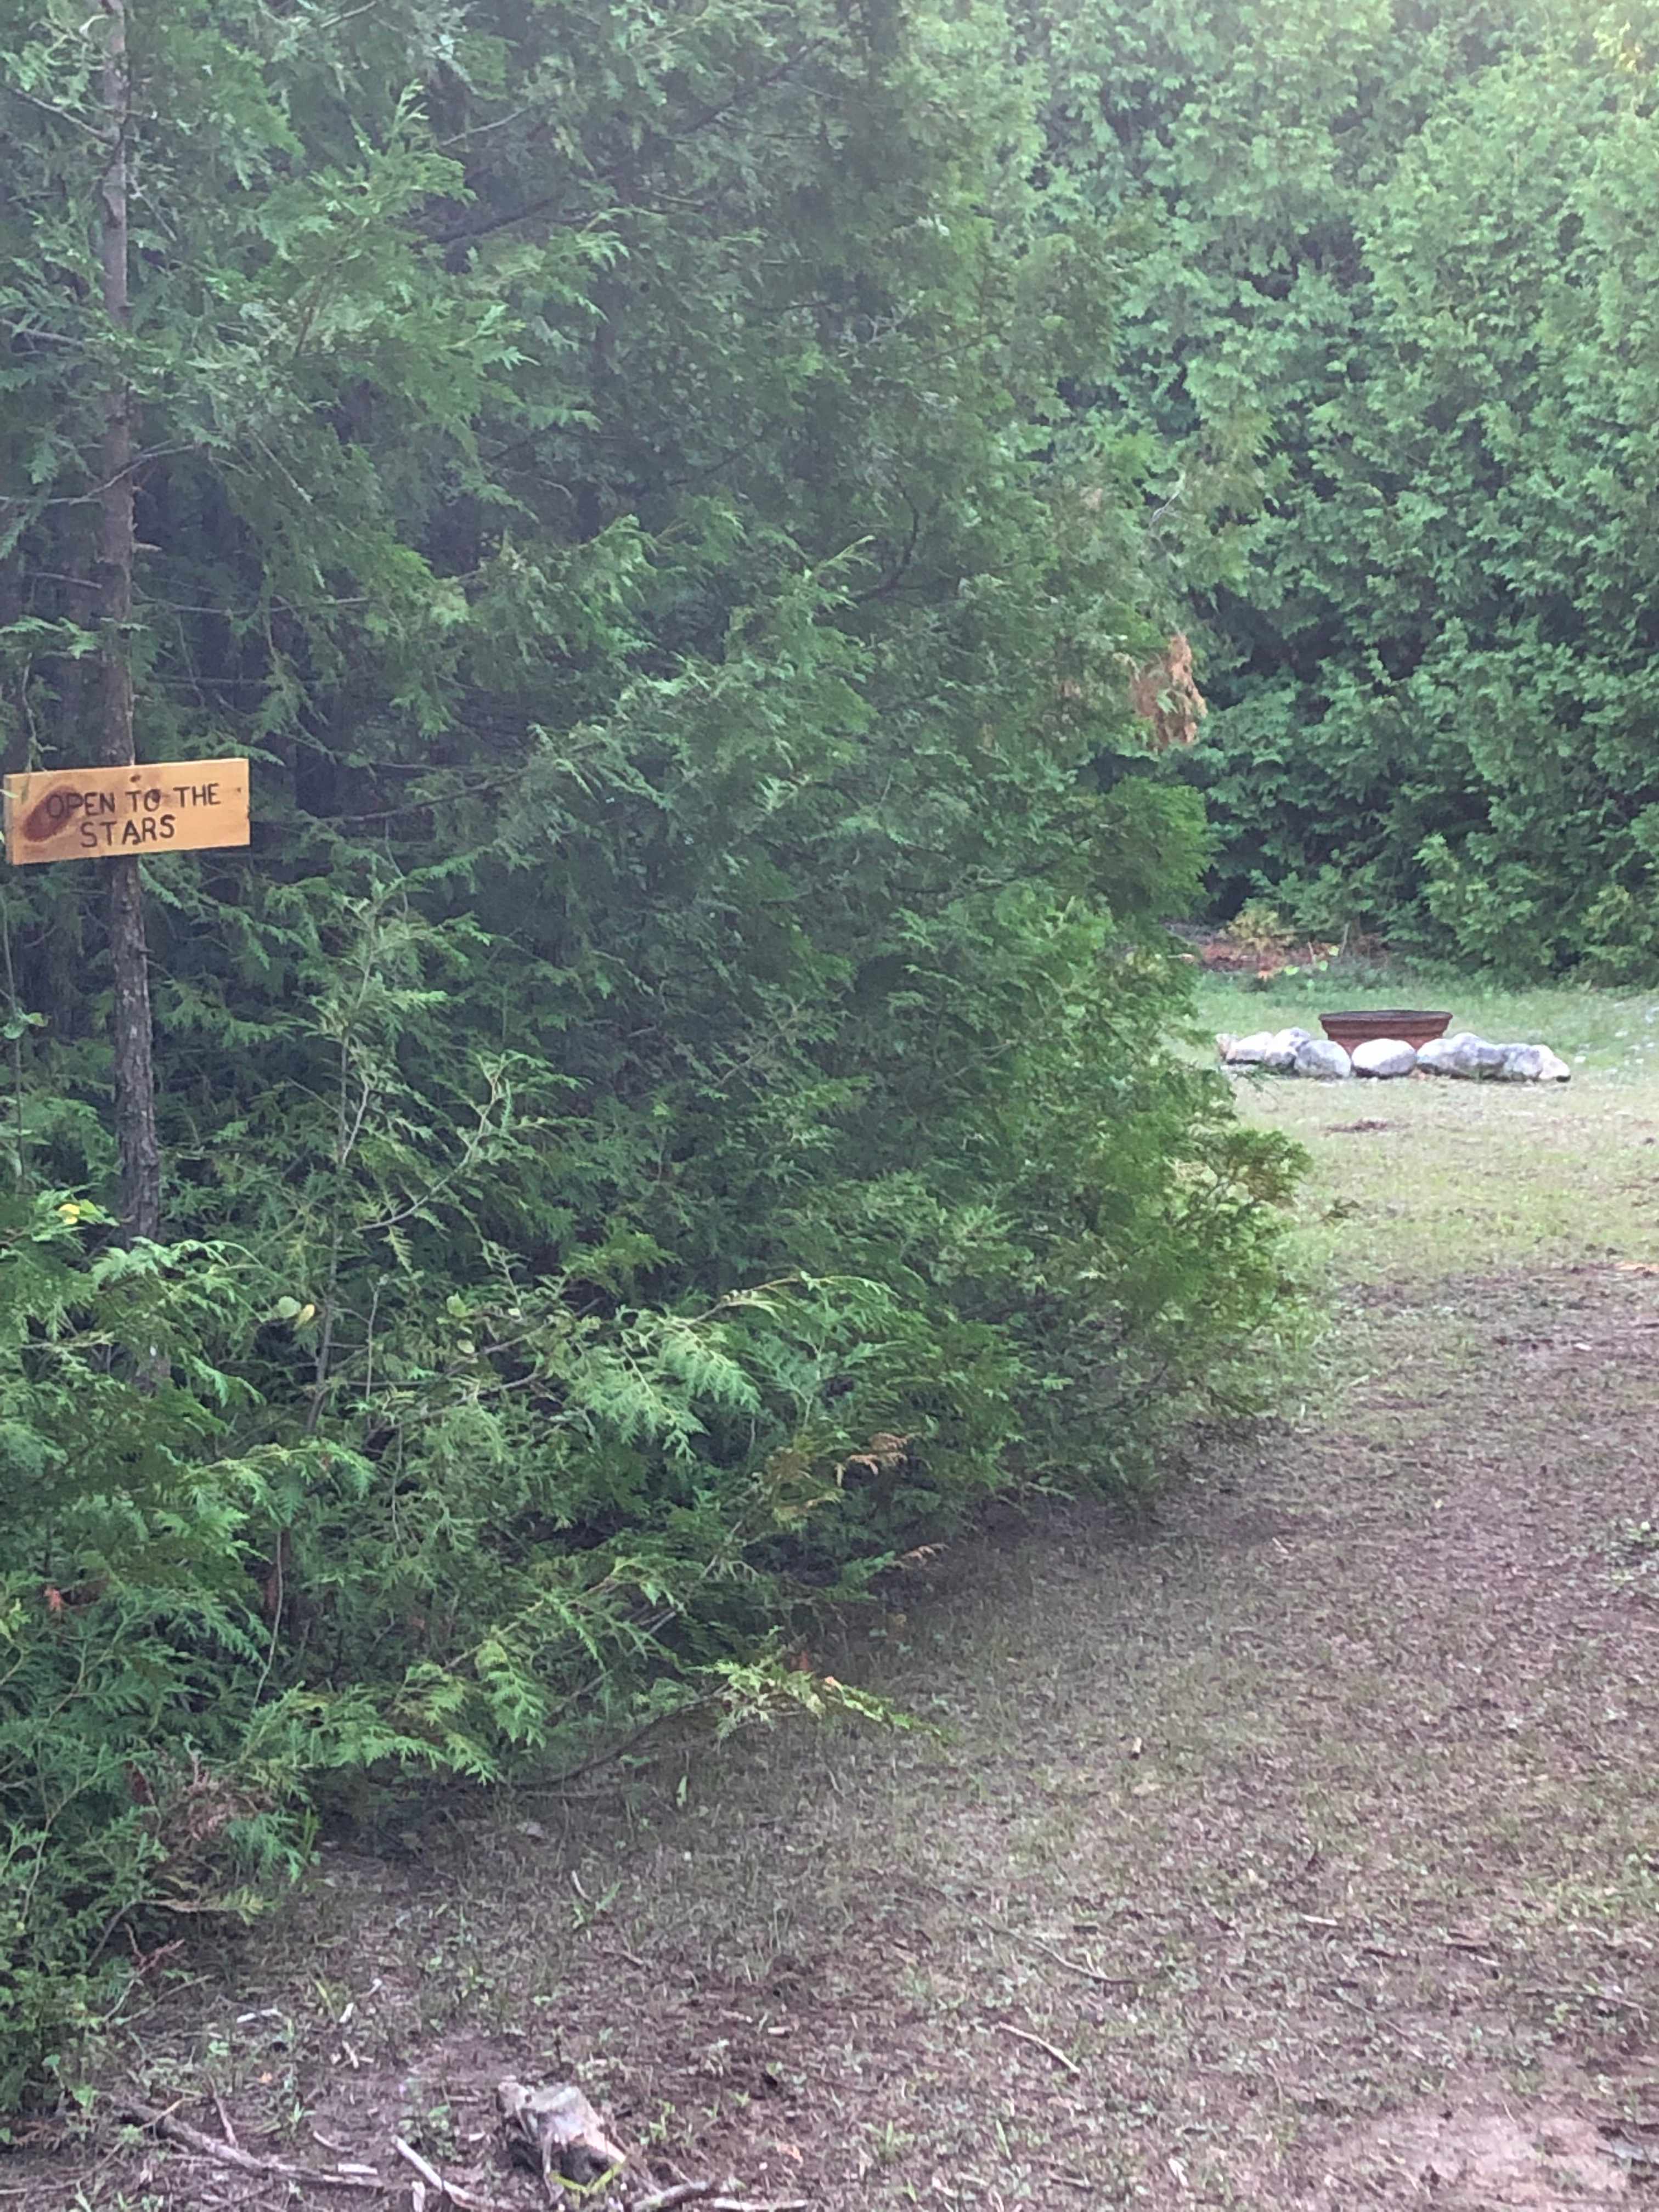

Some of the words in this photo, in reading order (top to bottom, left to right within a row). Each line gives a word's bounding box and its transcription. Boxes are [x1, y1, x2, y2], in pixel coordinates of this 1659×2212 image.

[46, 792, 115, 818] OPEN
[125, 789, 161, 812] TO
[173, 783, 221, 808] THE
[81, 814, 176, 848] STARS
